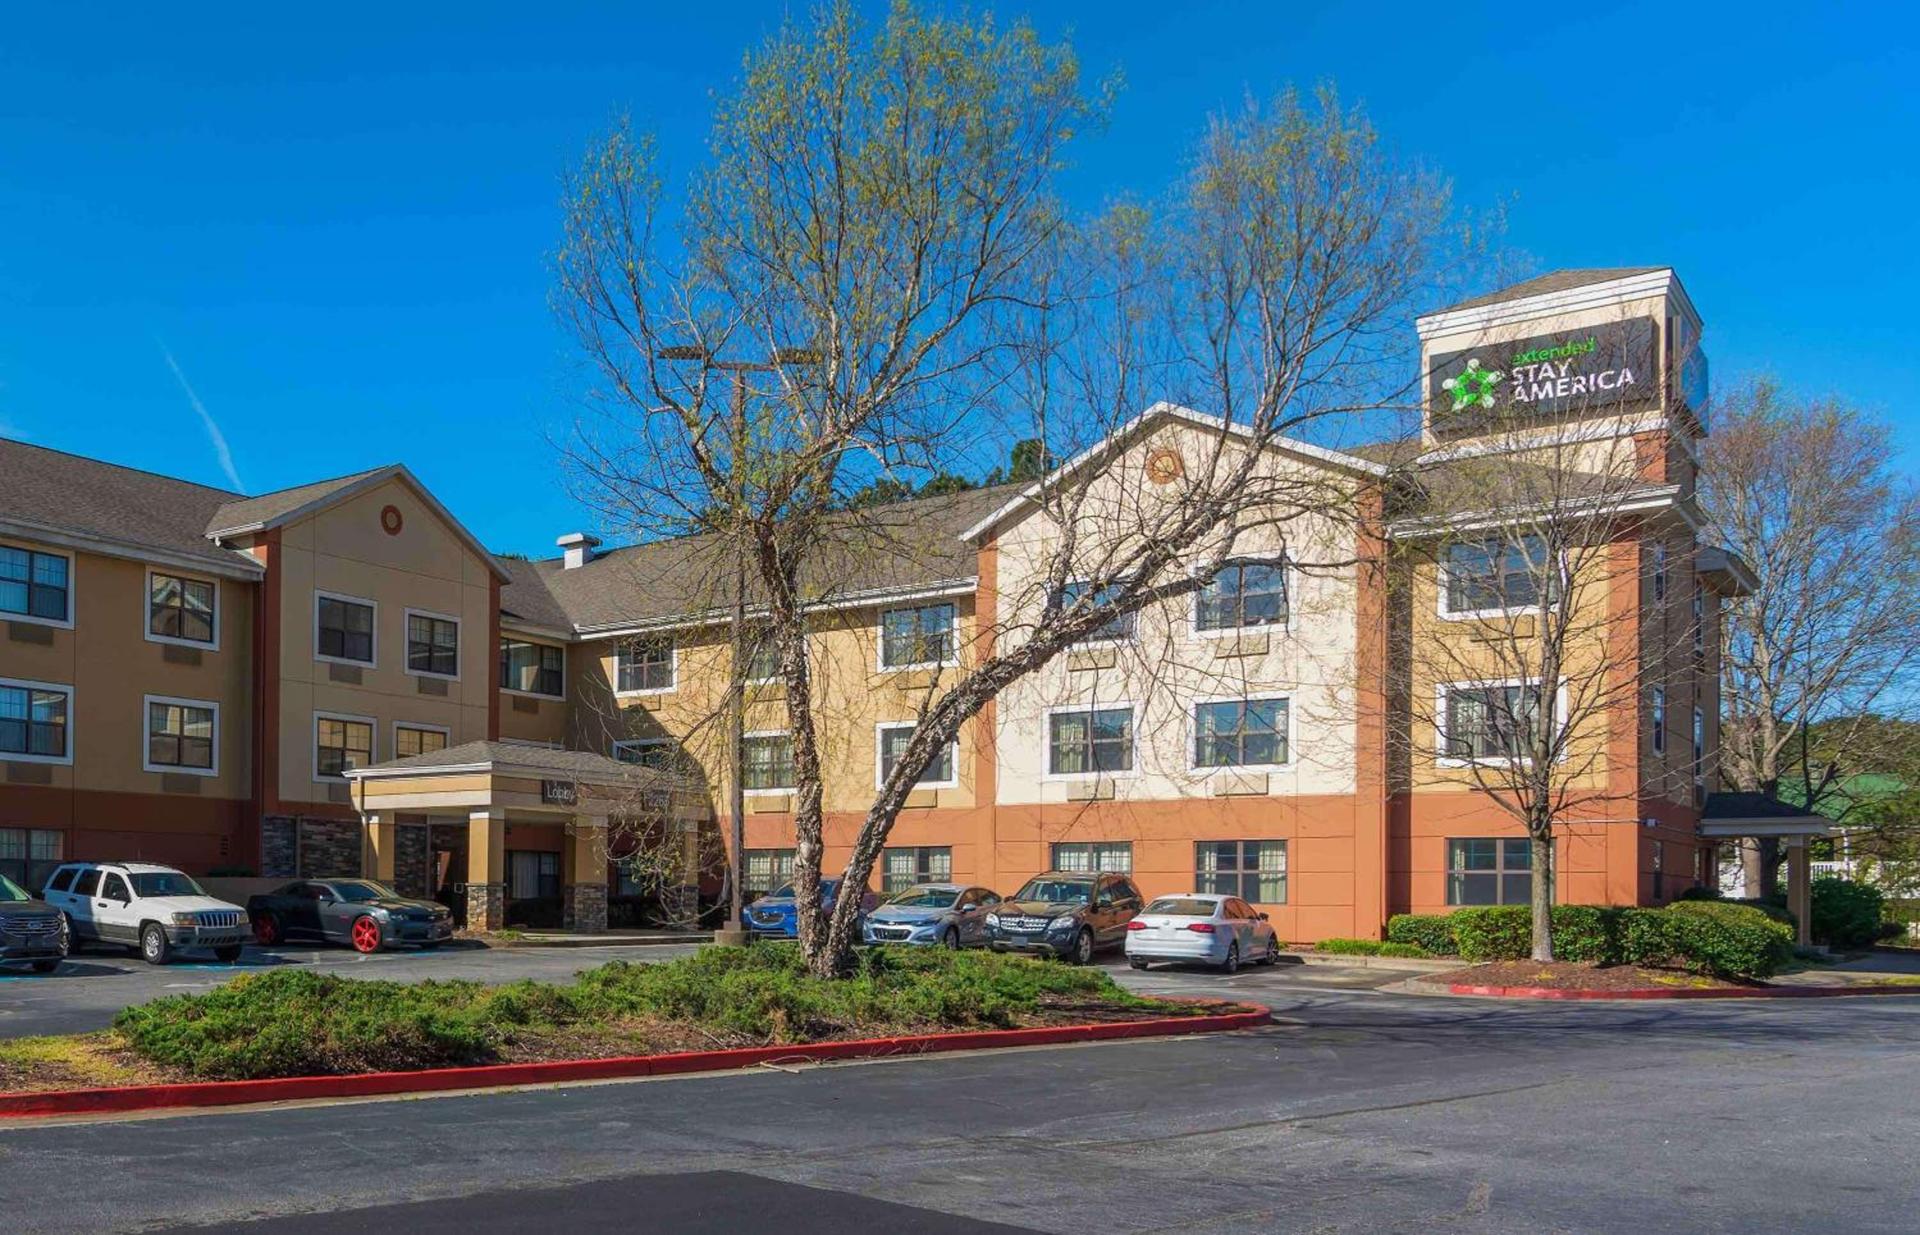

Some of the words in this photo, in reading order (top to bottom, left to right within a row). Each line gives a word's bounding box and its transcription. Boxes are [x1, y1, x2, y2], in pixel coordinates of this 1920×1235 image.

[1511, 336, 1595, 364] extended
[1511, 357, 1573, 385] STAY
[1514, 367, 1635, 402] AMERICA
